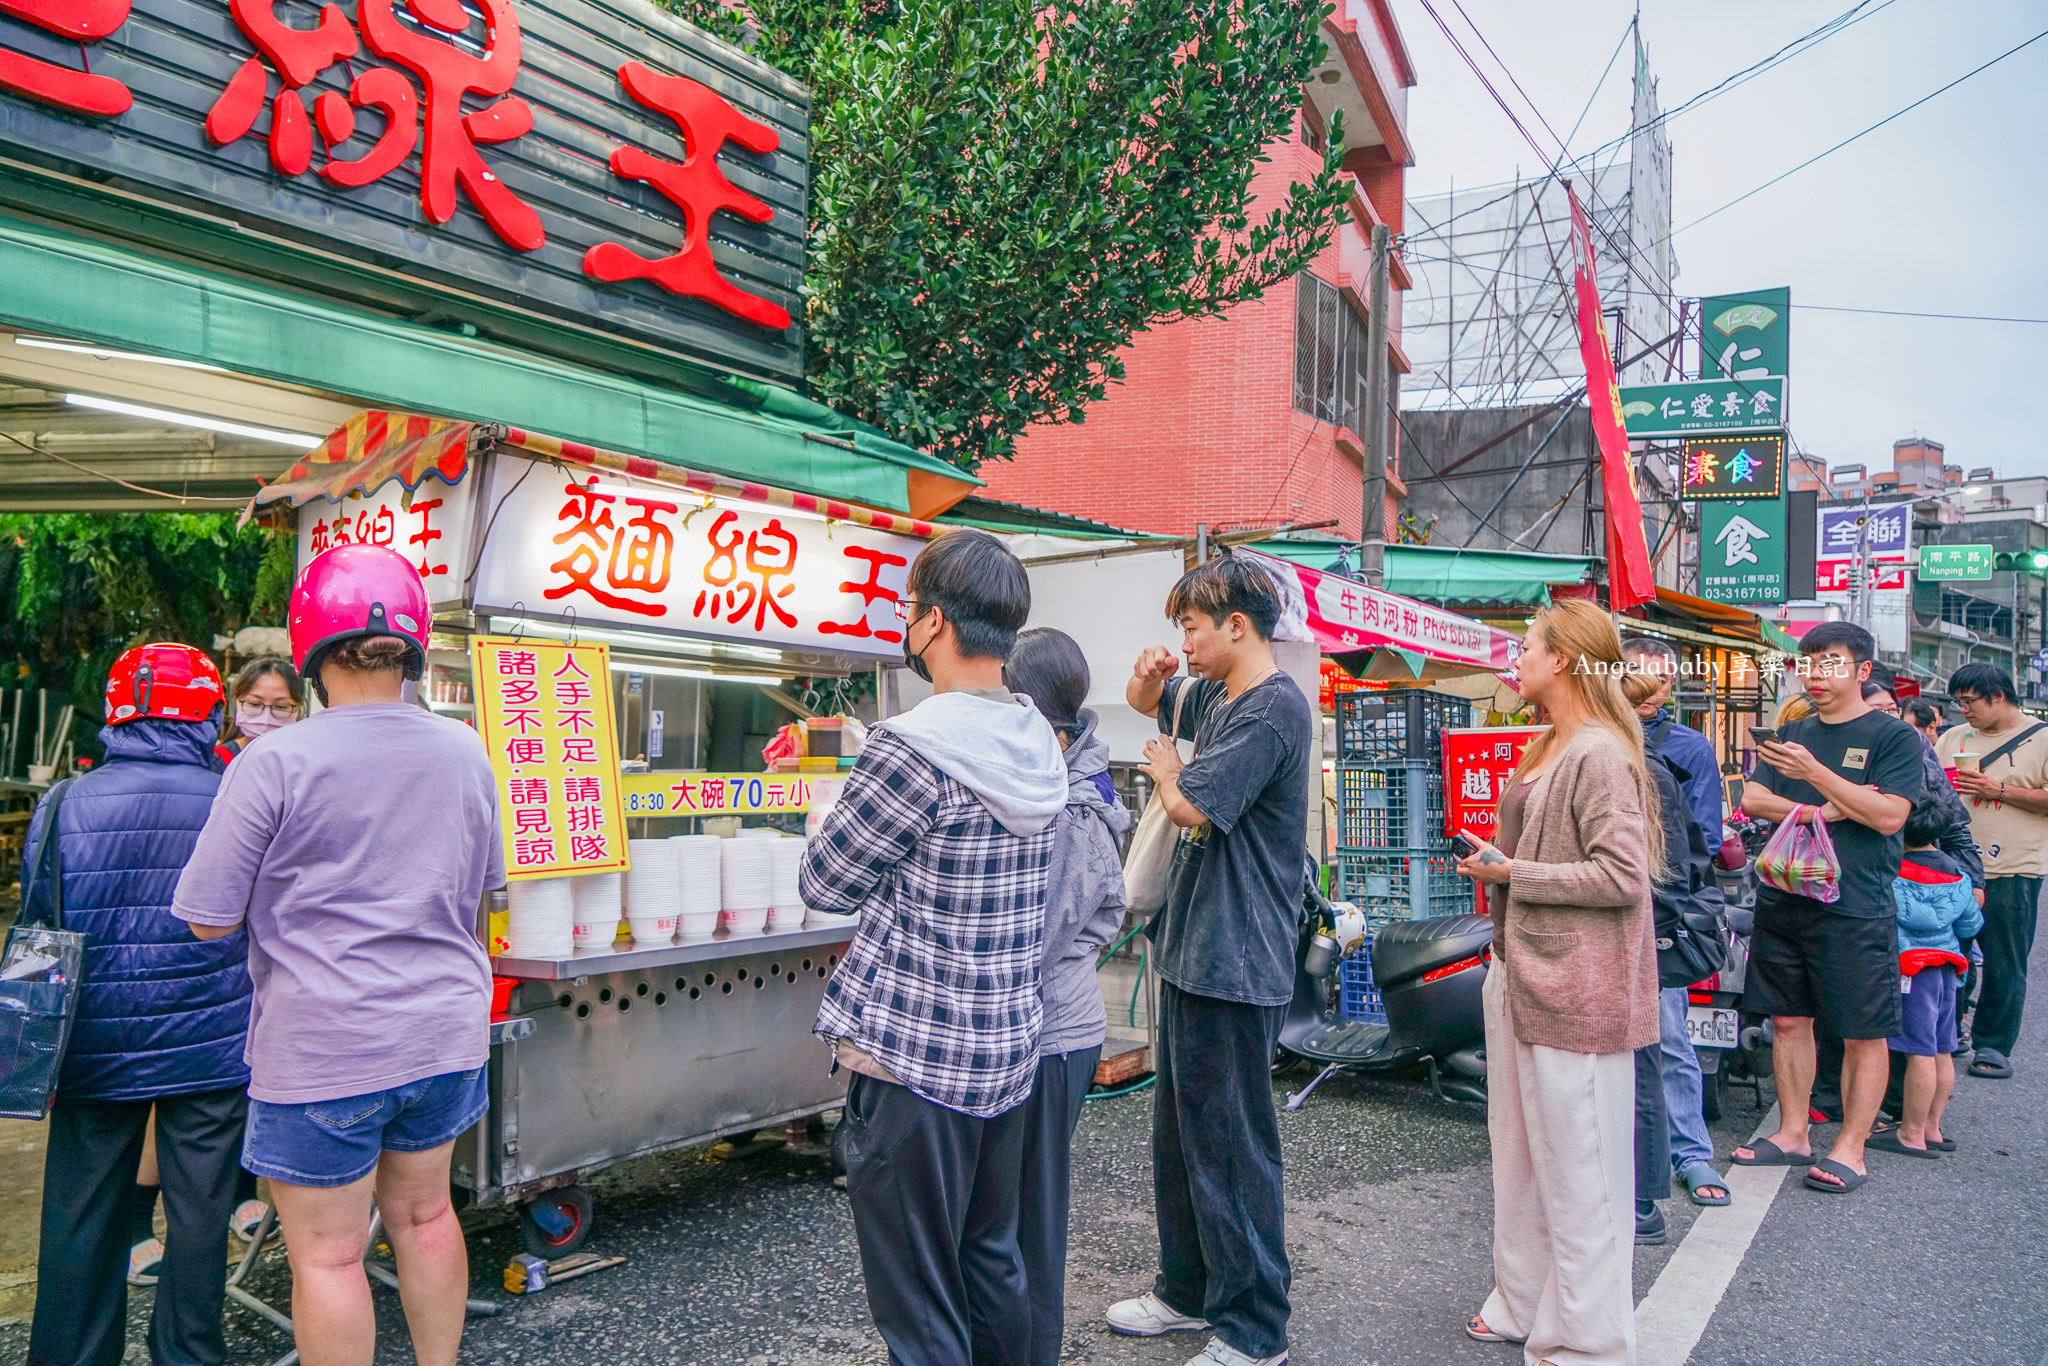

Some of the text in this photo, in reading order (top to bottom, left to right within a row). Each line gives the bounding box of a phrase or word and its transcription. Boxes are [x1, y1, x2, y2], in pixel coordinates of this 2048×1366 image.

[1660, 389, 1778, 420] 仁愛素食
[1686, 448, 1764, 486] 素食
[1714, 514, 1771, 567] 食
[1827, 516, 1902, 547] 全聯
[543, 475, 908, 646] 麵線王
[1930, 551, 1981, 563] 南平路
[1930, 565, 1981, 577] Nanping Rd.
[1705, 587, 1780, 599] 03-3167199
[1341, 588, 1418, 638] 牛肉河粉
[1494, 743, 1512, 762] 阿
